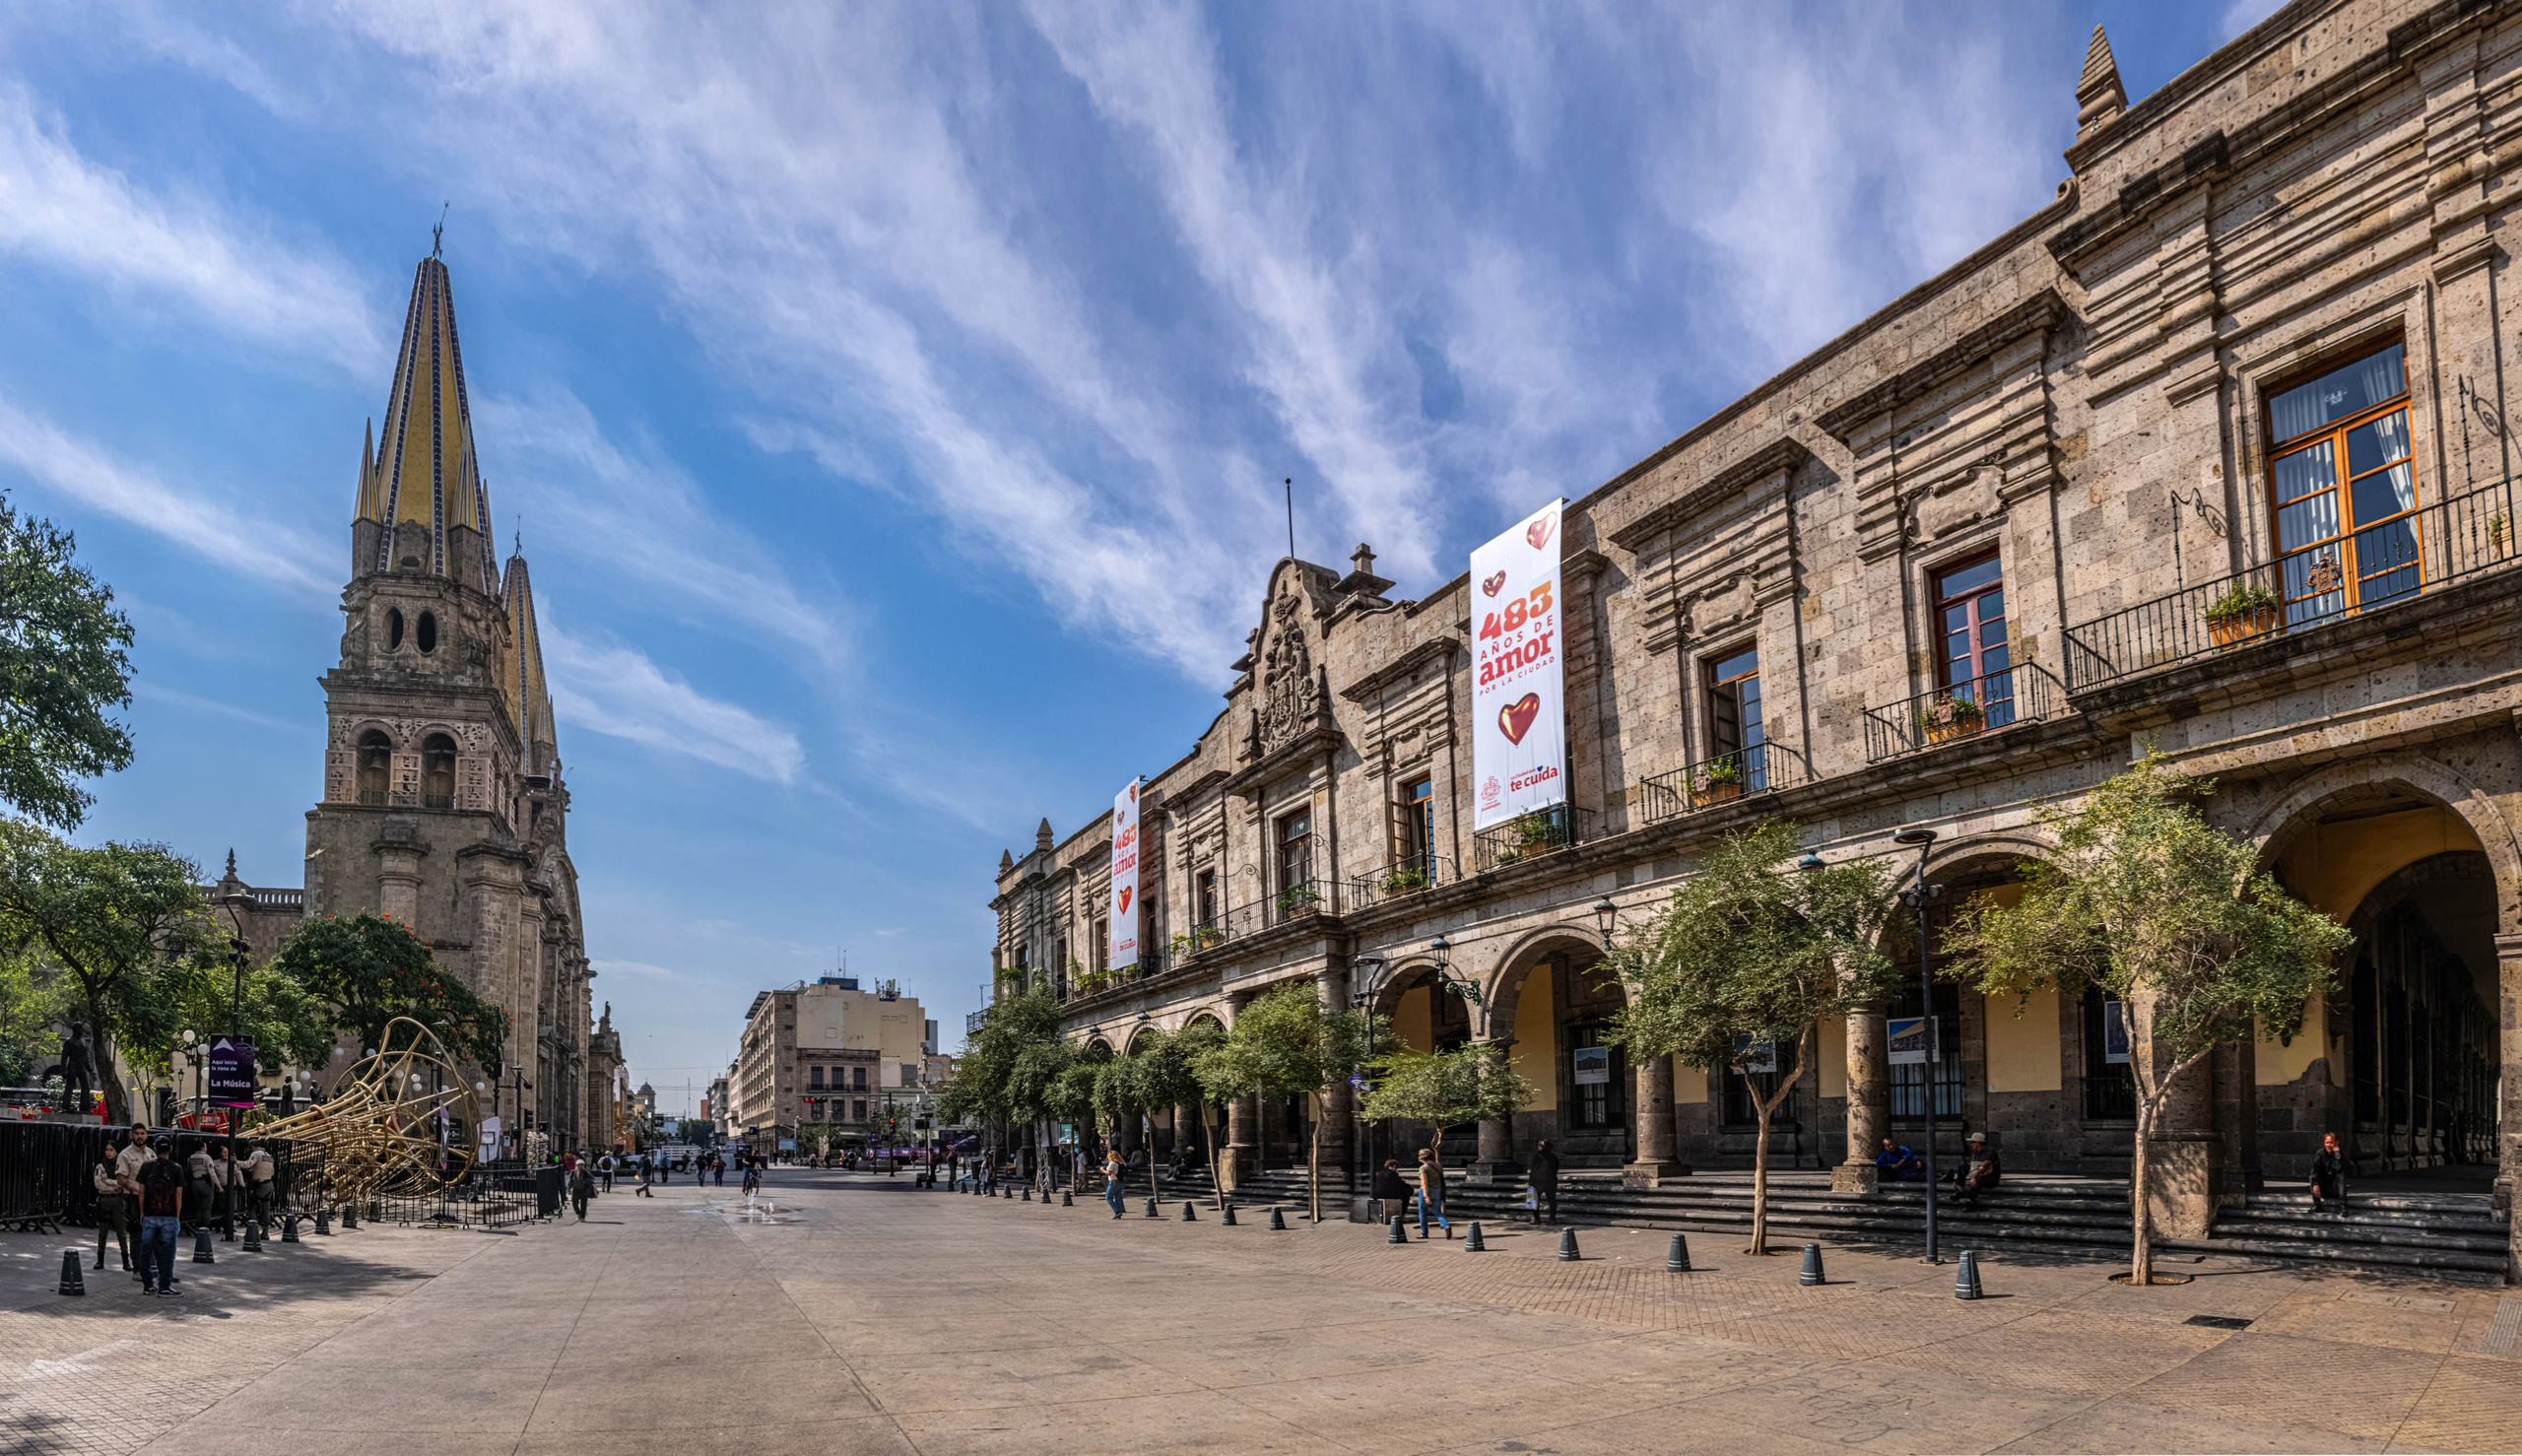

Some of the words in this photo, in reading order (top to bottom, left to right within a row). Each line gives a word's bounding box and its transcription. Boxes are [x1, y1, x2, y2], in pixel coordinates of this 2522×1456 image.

[1480, 580, 1553, 641] 483
[1480, 630, 1524, 661] AÑOS
[1534, 615, 1553, 633] DE
[1480, 629, 1554, 686] amor
[1480, 684, 1496, 696] POR
[1502, 677, 1512, 686] LA
[1518, 656, 1555, 678] CIUDAD
[1510, 780, 1522, 792] te
[1524, 765, 1558, 787] cuida
[1114, 853, 1136, 876] amor
